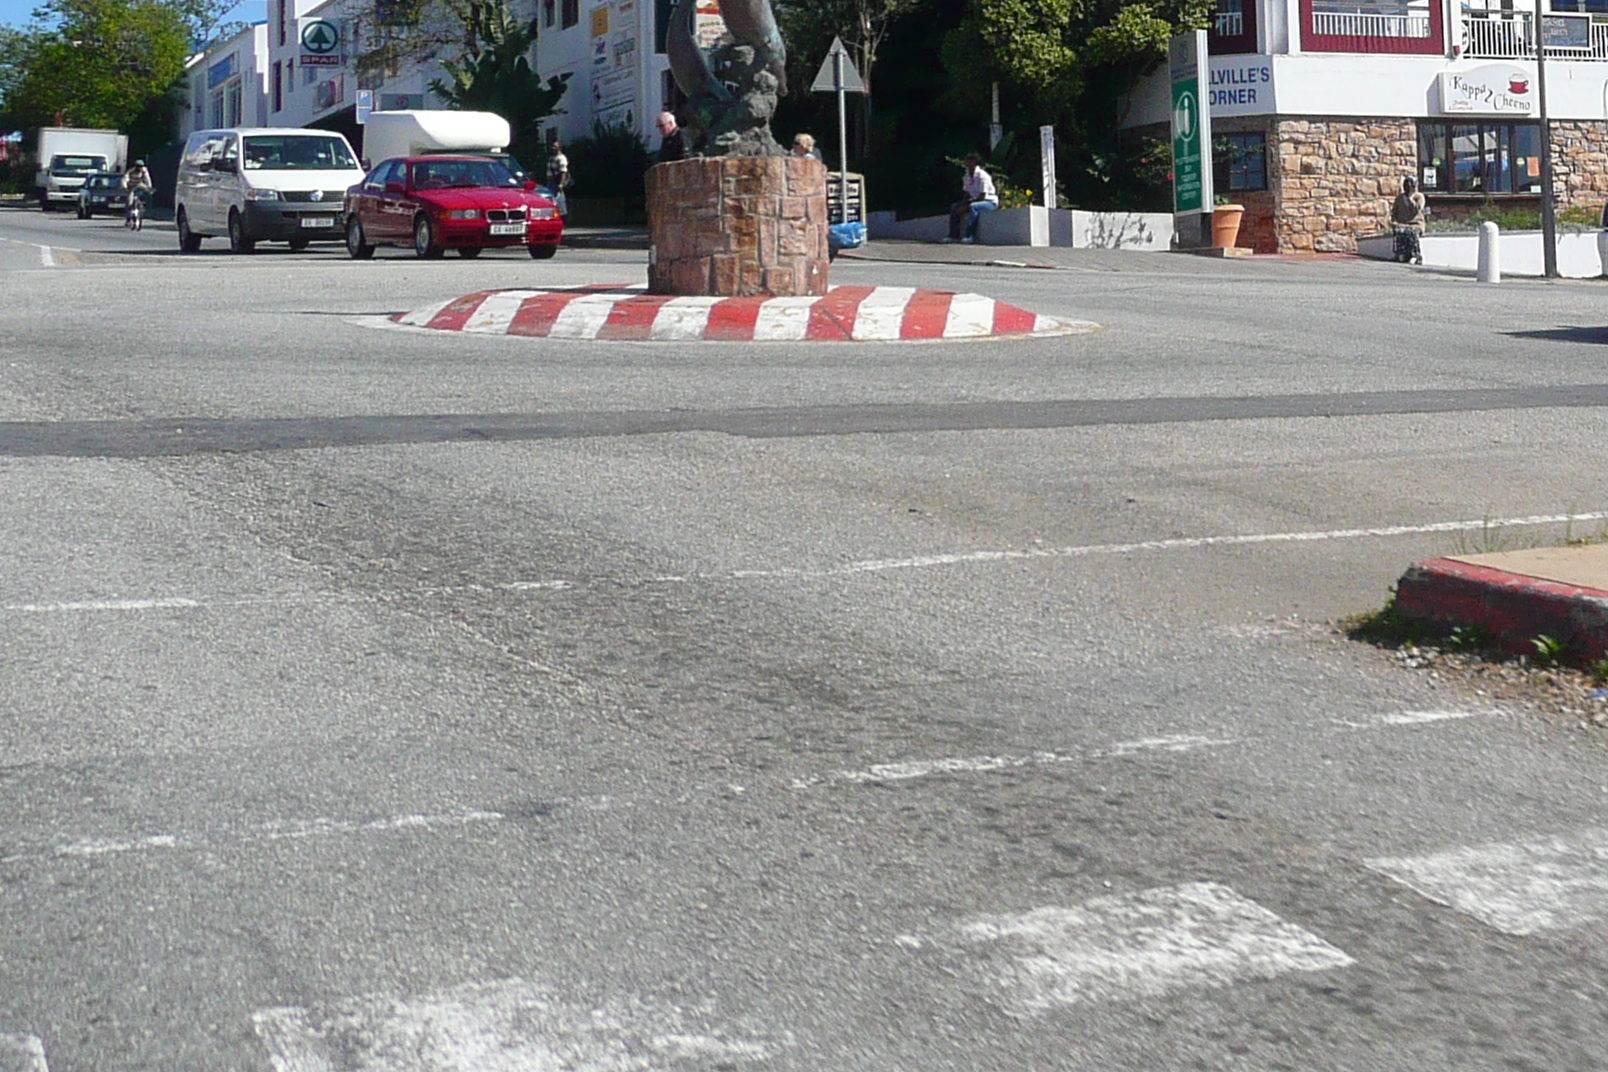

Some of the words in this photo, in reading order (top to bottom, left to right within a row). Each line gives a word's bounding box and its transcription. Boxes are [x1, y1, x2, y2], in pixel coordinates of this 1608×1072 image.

[301, 55, 339, 65] SPAR
[1209, 66, 1270, 86] LVILLE'S
[1209, 88, 1257, 106] ORNER
